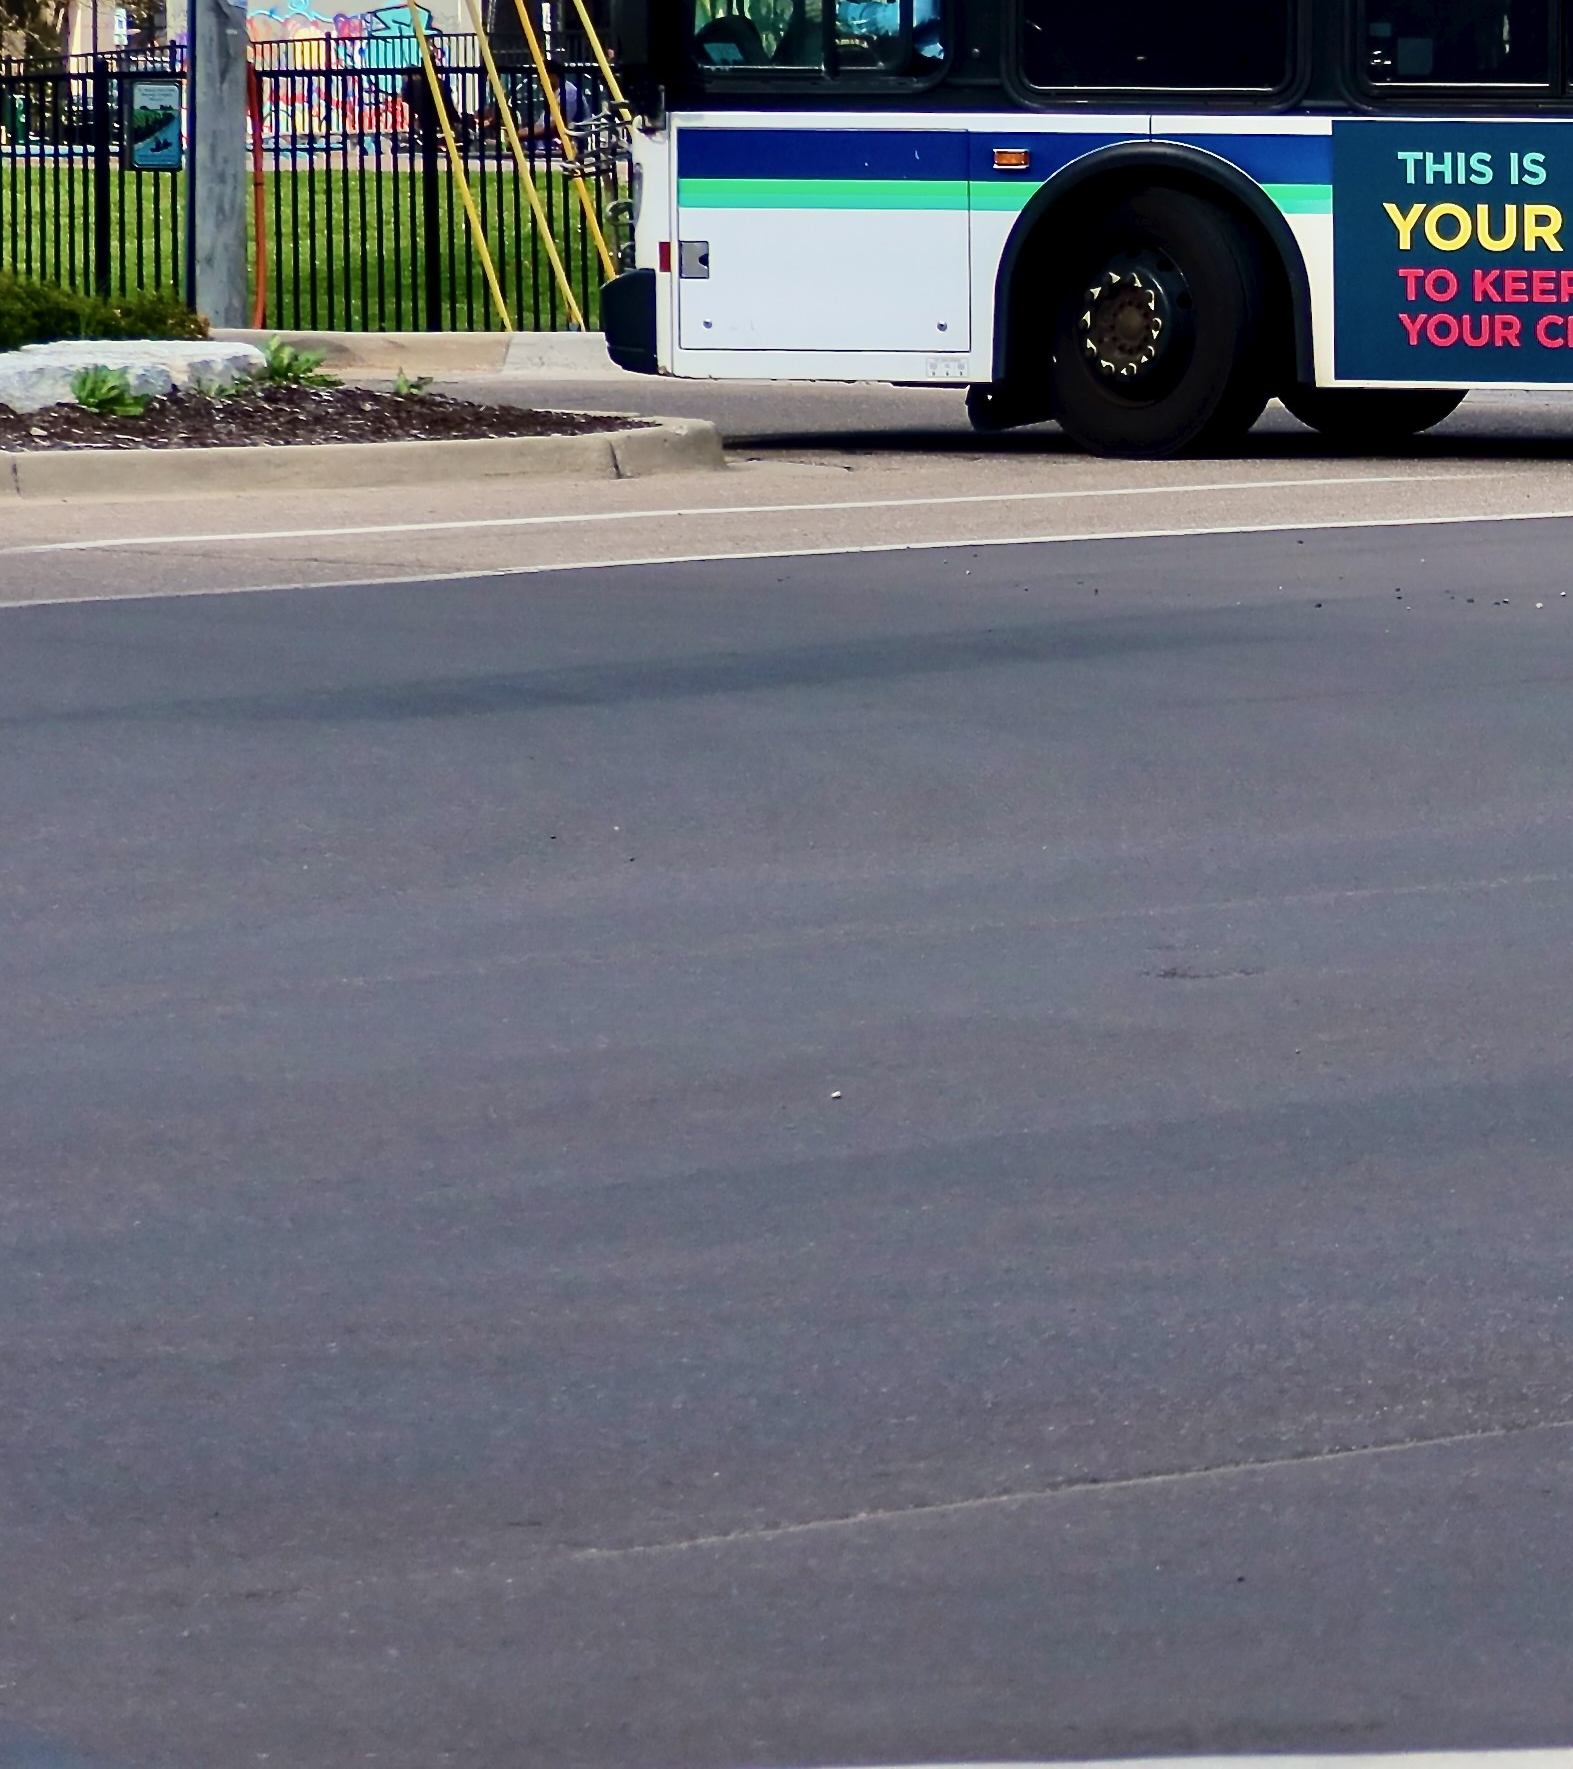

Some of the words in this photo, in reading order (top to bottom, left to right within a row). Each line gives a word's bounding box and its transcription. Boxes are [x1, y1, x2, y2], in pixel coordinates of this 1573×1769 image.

[1397, 151, 1494, 185] THIS
[1509, 152, 1547, 186] IS
[1382, 202, 1564, 253] YOUR
[1398, 268, 1458, 303] TO
[1398, 313, 1521, 348] YOUR
